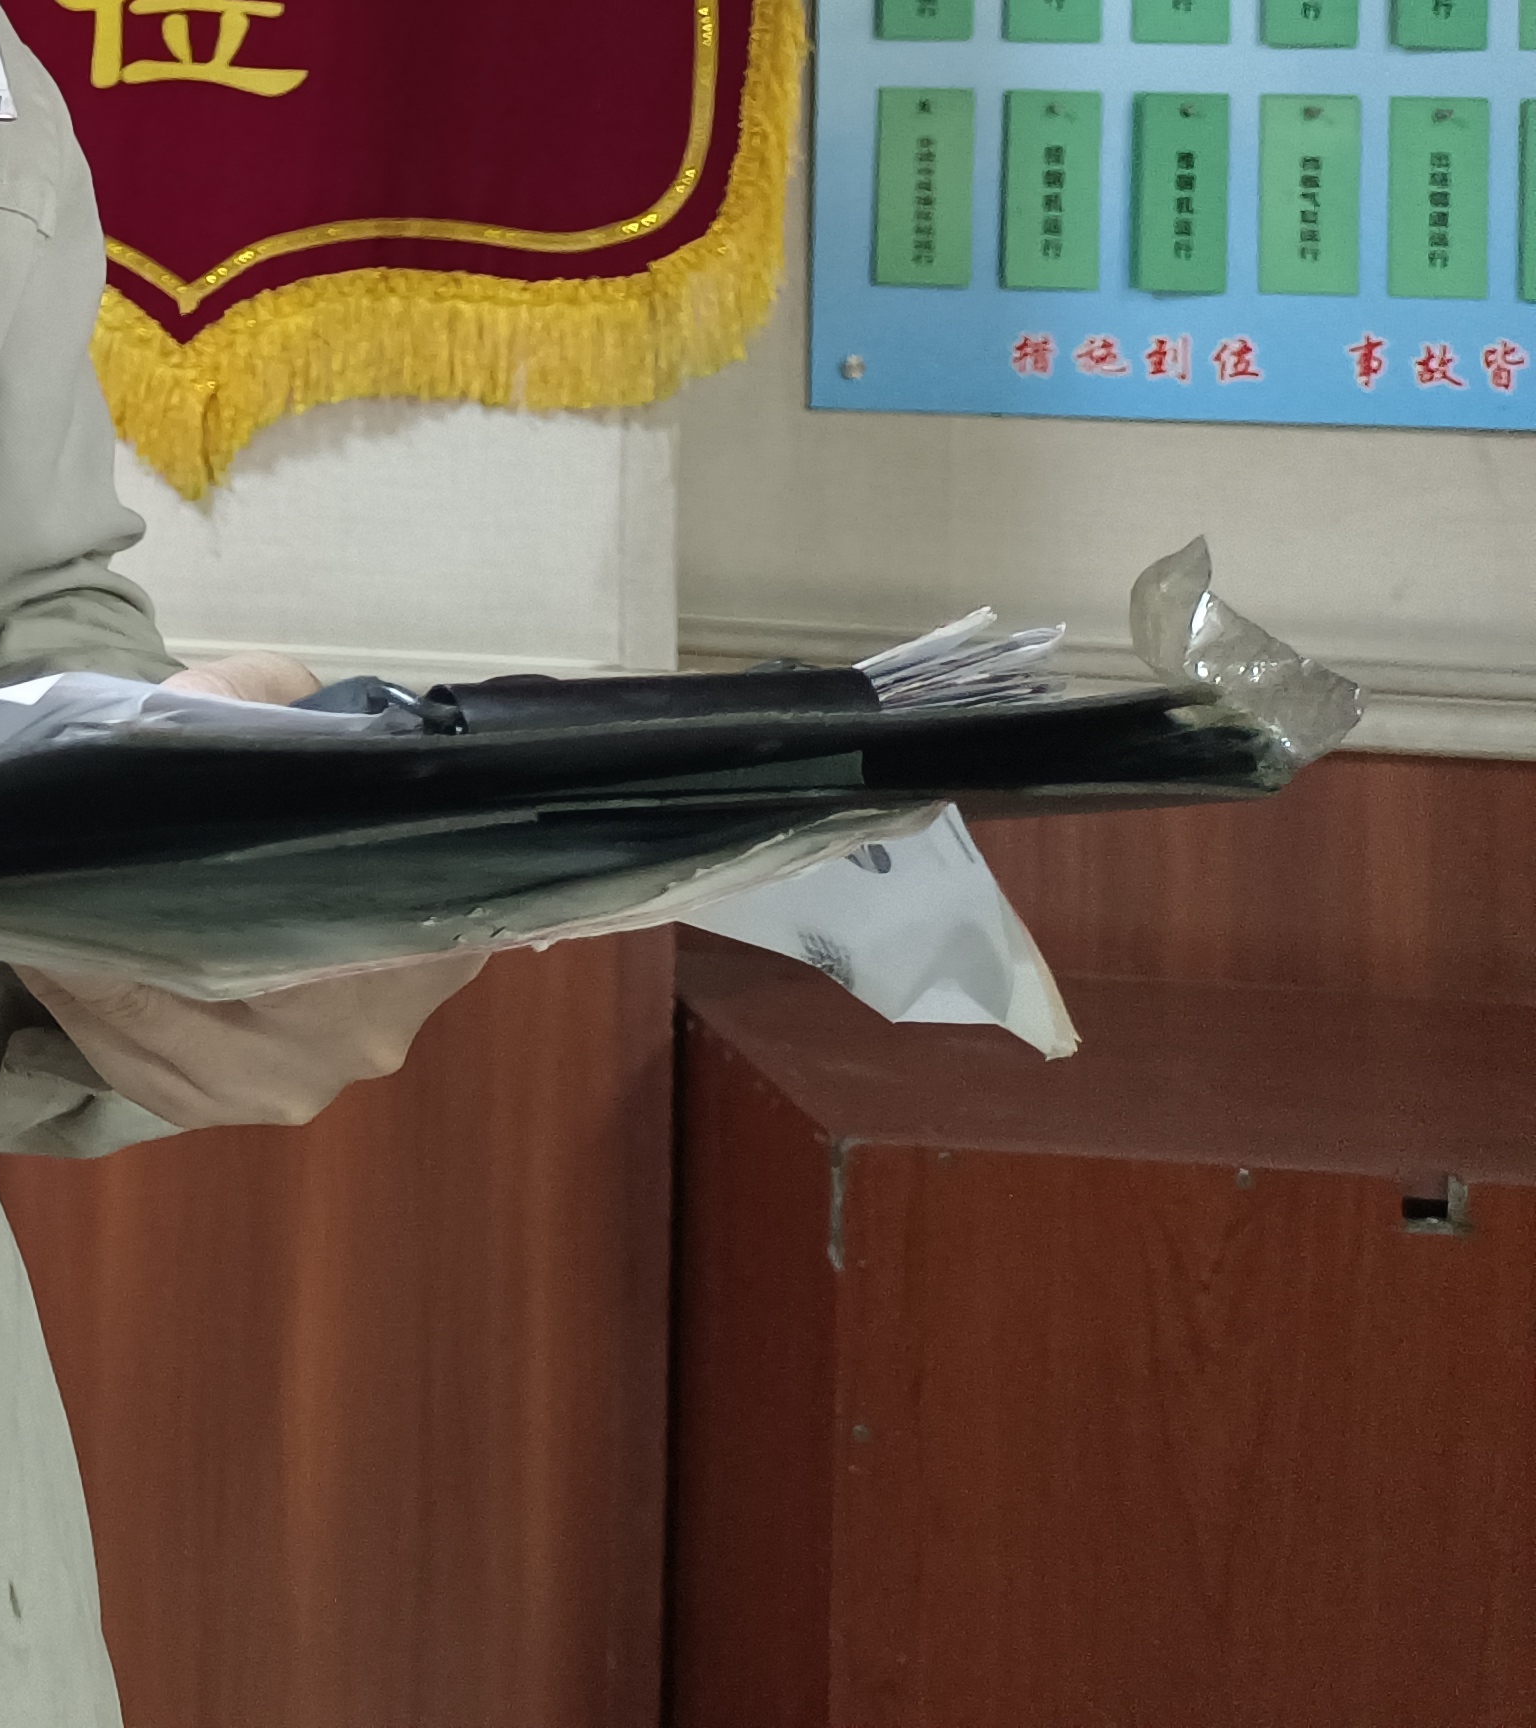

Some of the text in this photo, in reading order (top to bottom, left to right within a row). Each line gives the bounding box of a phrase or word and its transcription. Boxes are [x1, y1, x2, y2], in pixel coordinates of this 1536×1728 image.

[1014, 334, 1527, 390] 措施到位 事故皆
